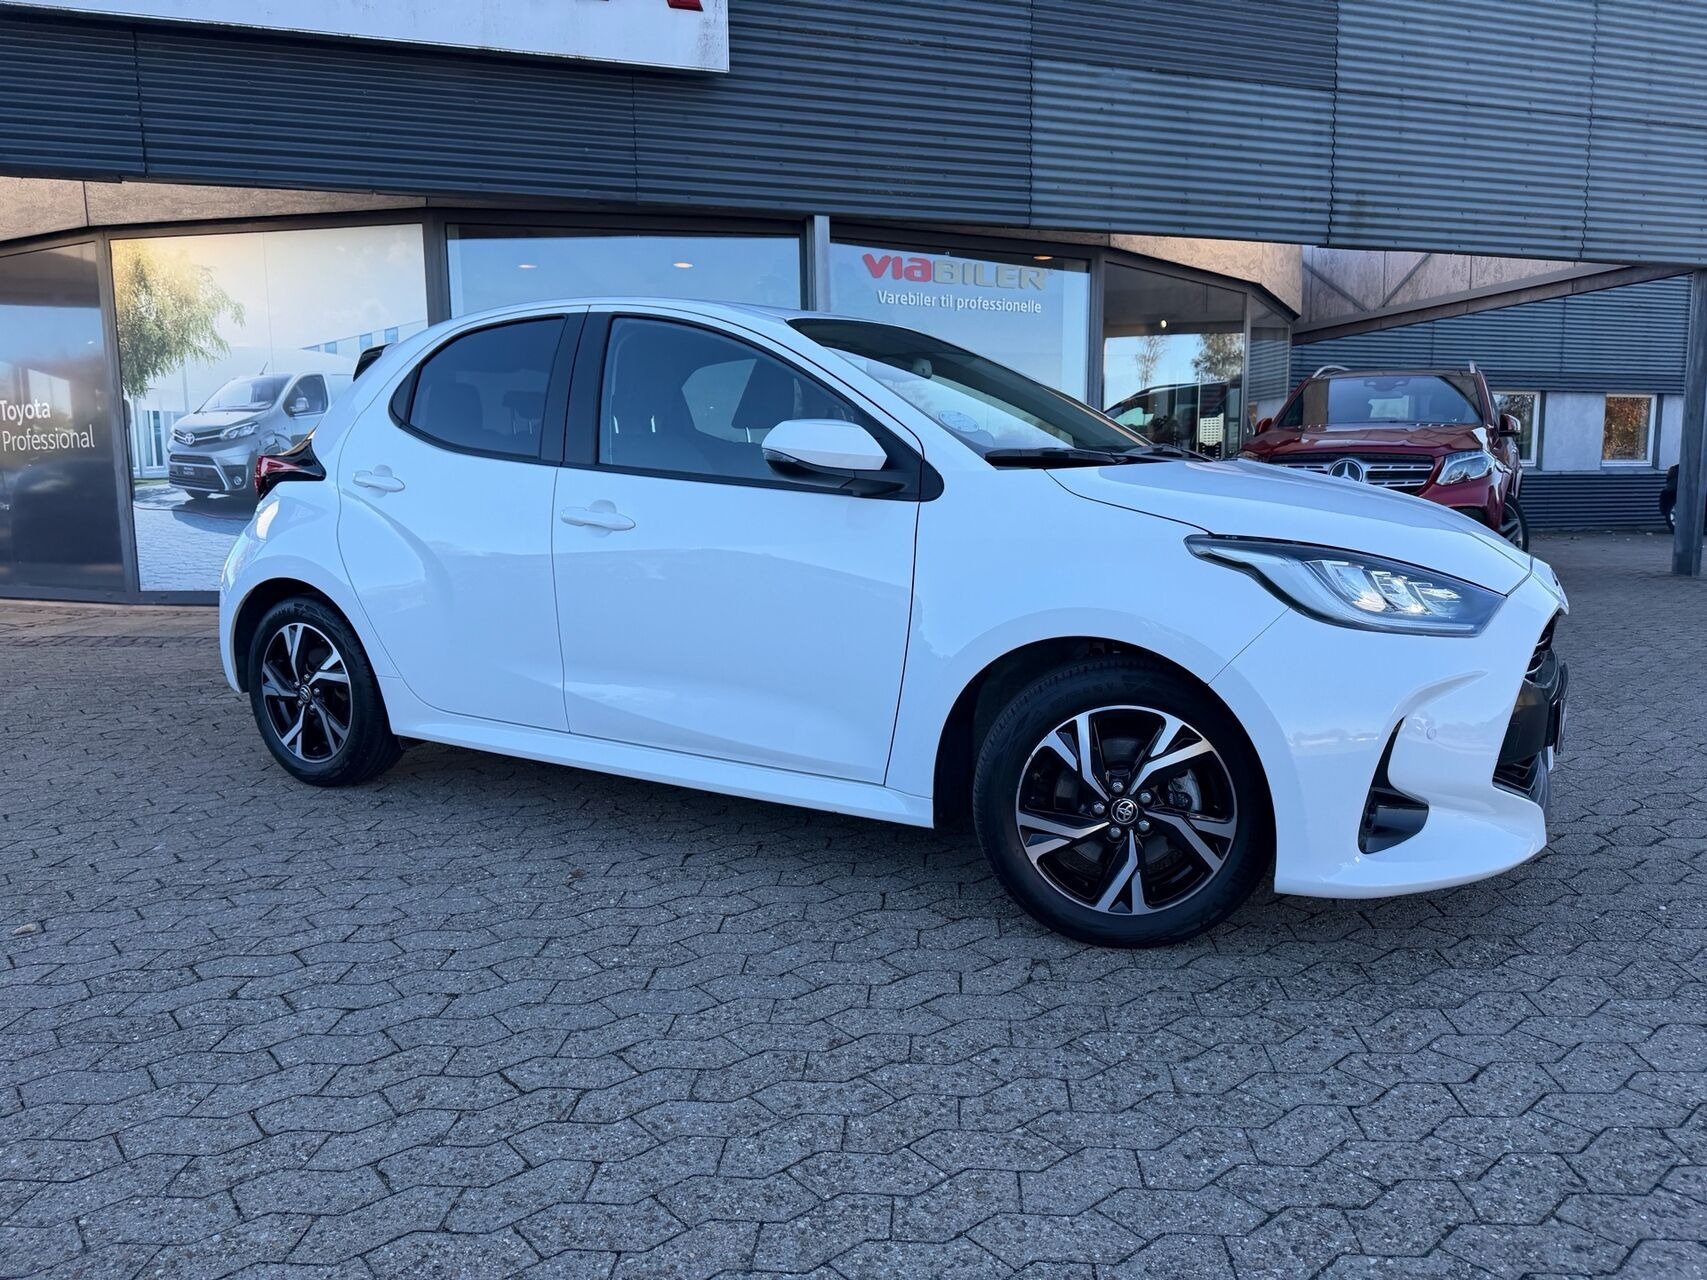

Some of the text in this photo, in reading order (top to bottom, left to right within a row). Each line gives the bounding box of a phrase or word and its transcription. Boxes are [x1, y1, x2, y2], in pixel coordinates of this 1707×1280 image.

[877, 290, 1042, 313] Varebiler til professionelle
[0, 399, 51, 426] Toyota
[2, 424, 96, 452] Professional
